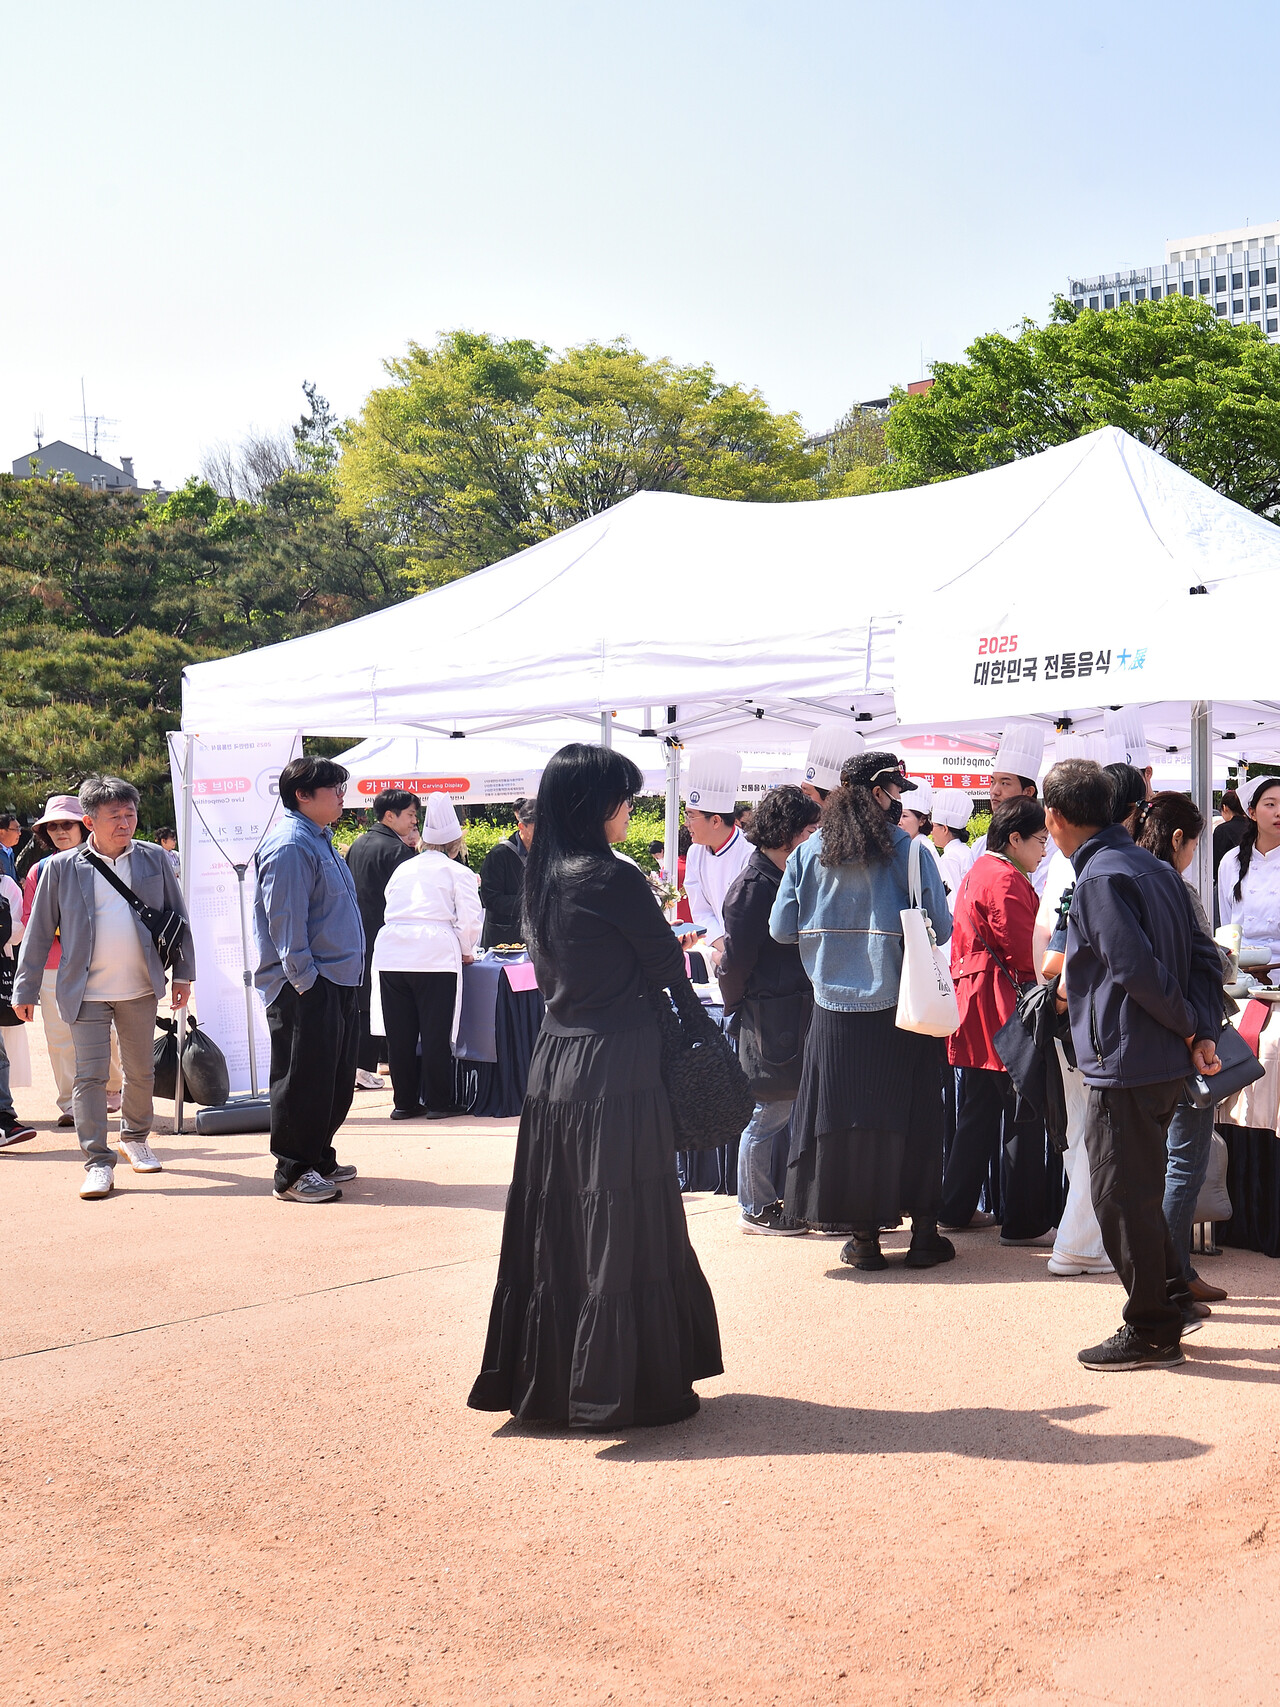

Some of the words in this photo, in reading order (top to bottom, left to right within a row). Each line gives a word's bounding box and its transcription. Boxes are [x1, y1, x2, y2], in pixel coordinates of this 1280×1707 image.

[978, 635, 1018, 655] 2025
[974, 657, 1038, 685] 대한민국
[1044, 649, 1112, 680] 전통음식
[444, 781, 464, 789] Display
